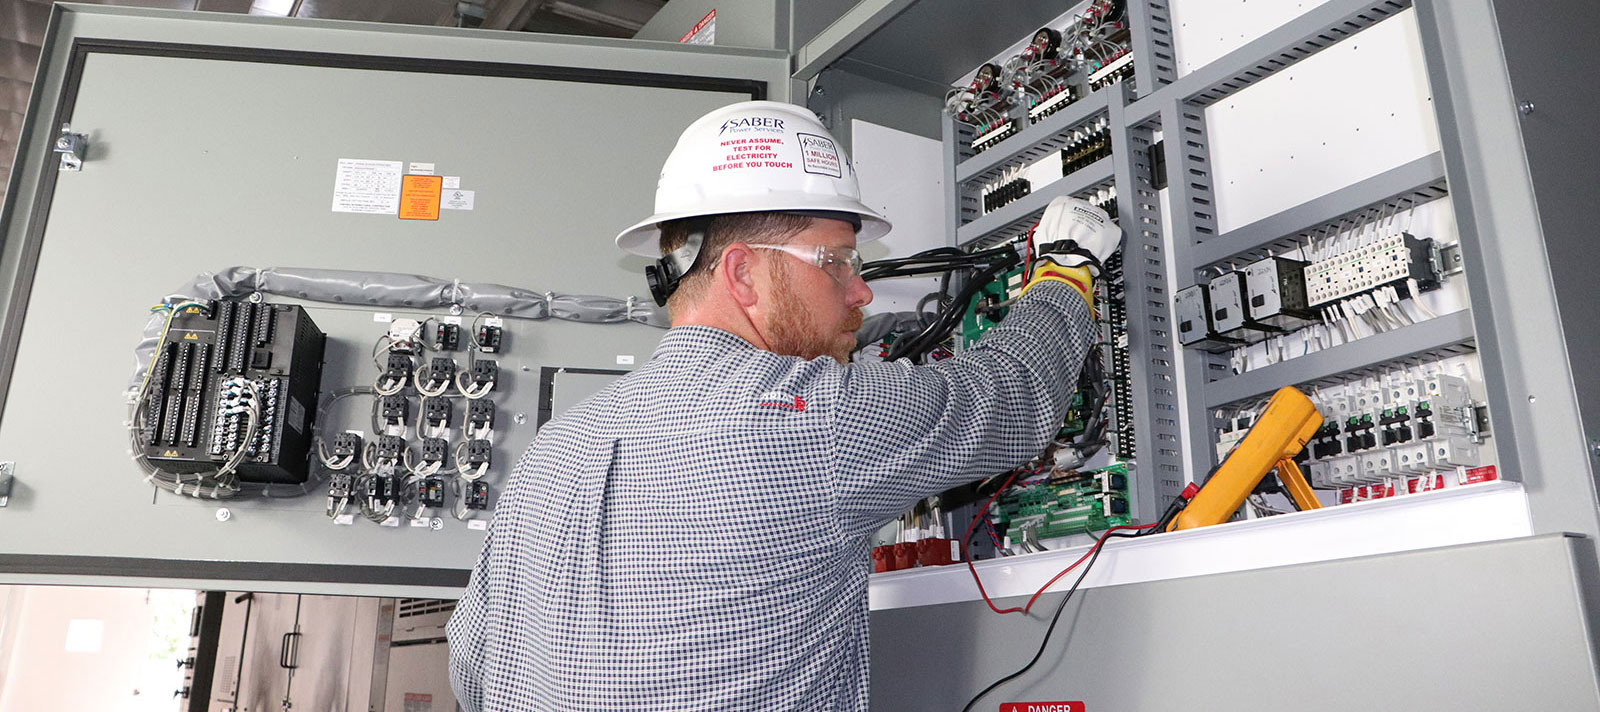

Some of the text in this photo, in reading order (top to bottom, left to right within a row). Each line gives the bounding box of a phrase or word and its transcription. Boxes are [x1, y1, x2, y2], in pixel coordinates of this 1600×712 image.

[730, 117, 785, 129] SABER
[720, 139, 747, 147] NEVER
[726, 153, 778, 161] ELECTRICITY
[811, 150, 837, 161] MILLION
[712, 162, 744, 171] BEFORE
[1028, 704, 1071, 712] DANGER
